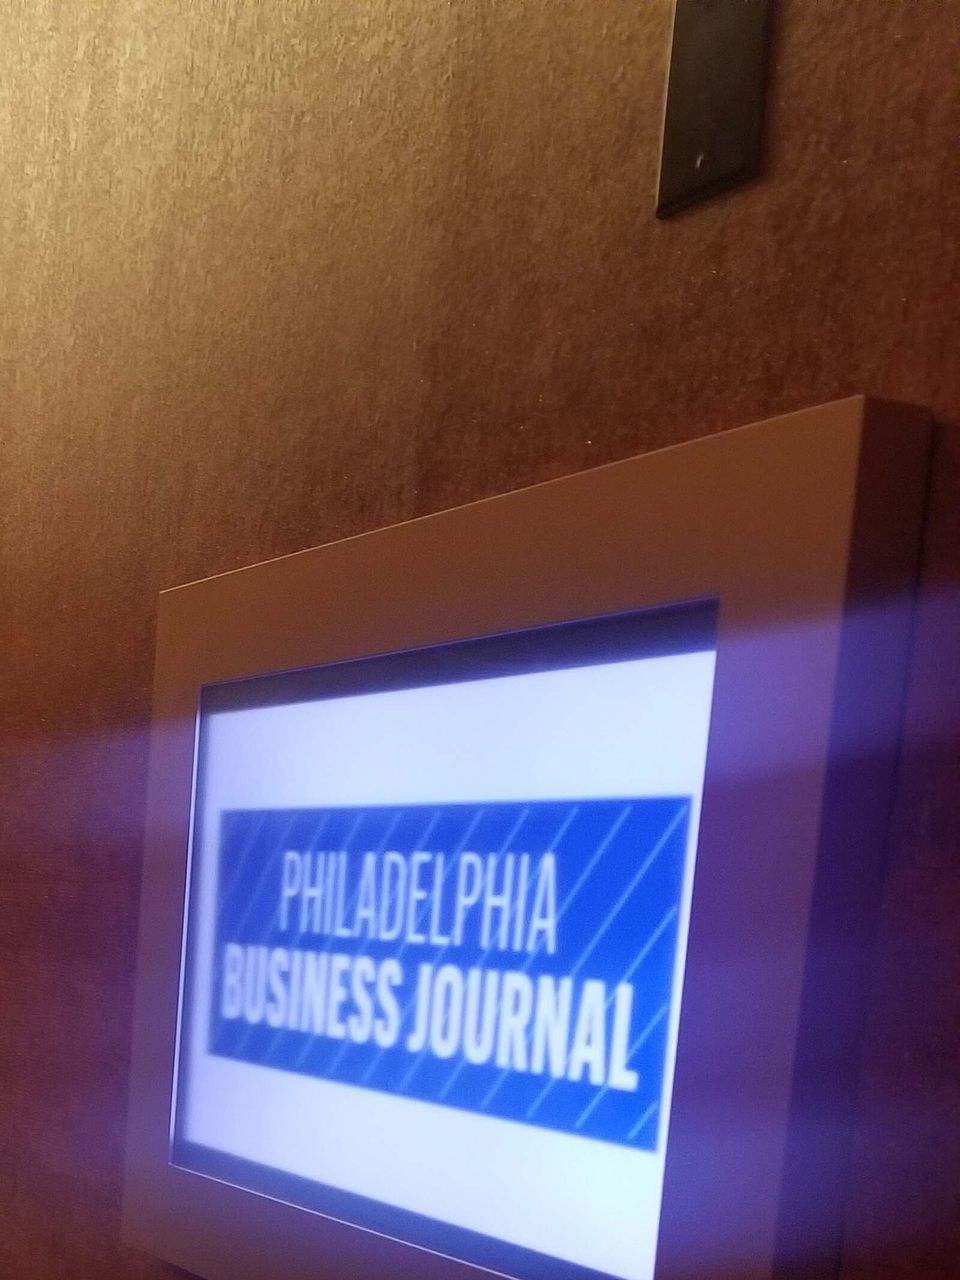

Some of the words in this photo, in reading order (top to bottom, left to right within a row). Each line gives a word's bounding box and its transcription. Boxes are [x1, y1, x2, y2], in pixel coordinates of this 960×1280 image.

[278, 849, 558, 956] PHILADELPHIA
[220, 943, 404, 1050] BUSINESS
[407, 964, 639, 1091] JOURNAL
